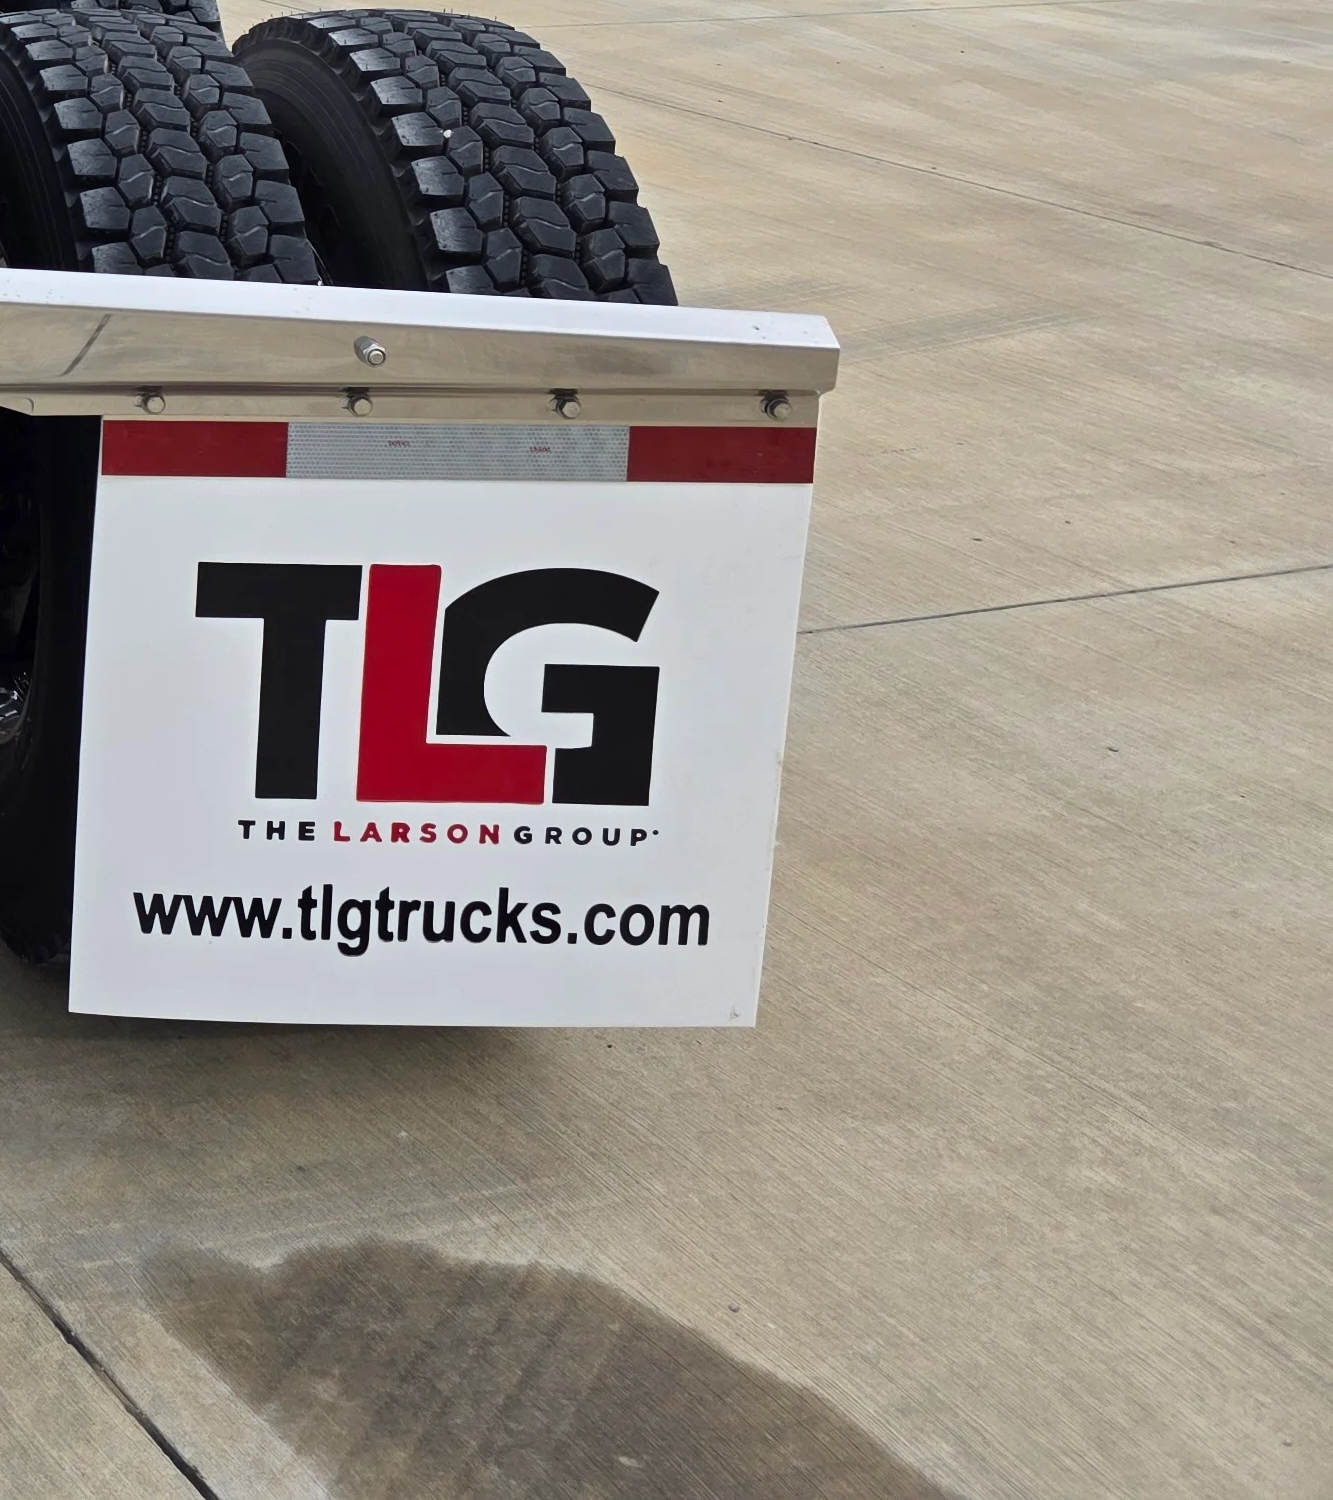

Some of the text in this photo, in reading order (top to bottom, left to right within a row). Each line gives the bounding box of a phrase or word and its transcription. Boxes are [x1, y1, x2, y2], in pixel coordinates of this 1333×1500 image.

[195, 561, 661, 808] TLG
[237, 819, 317, 842] THE
[332, 820, 501, 845] LARSON
[132, 882, 712, 958] www.tlgtrucks.com
